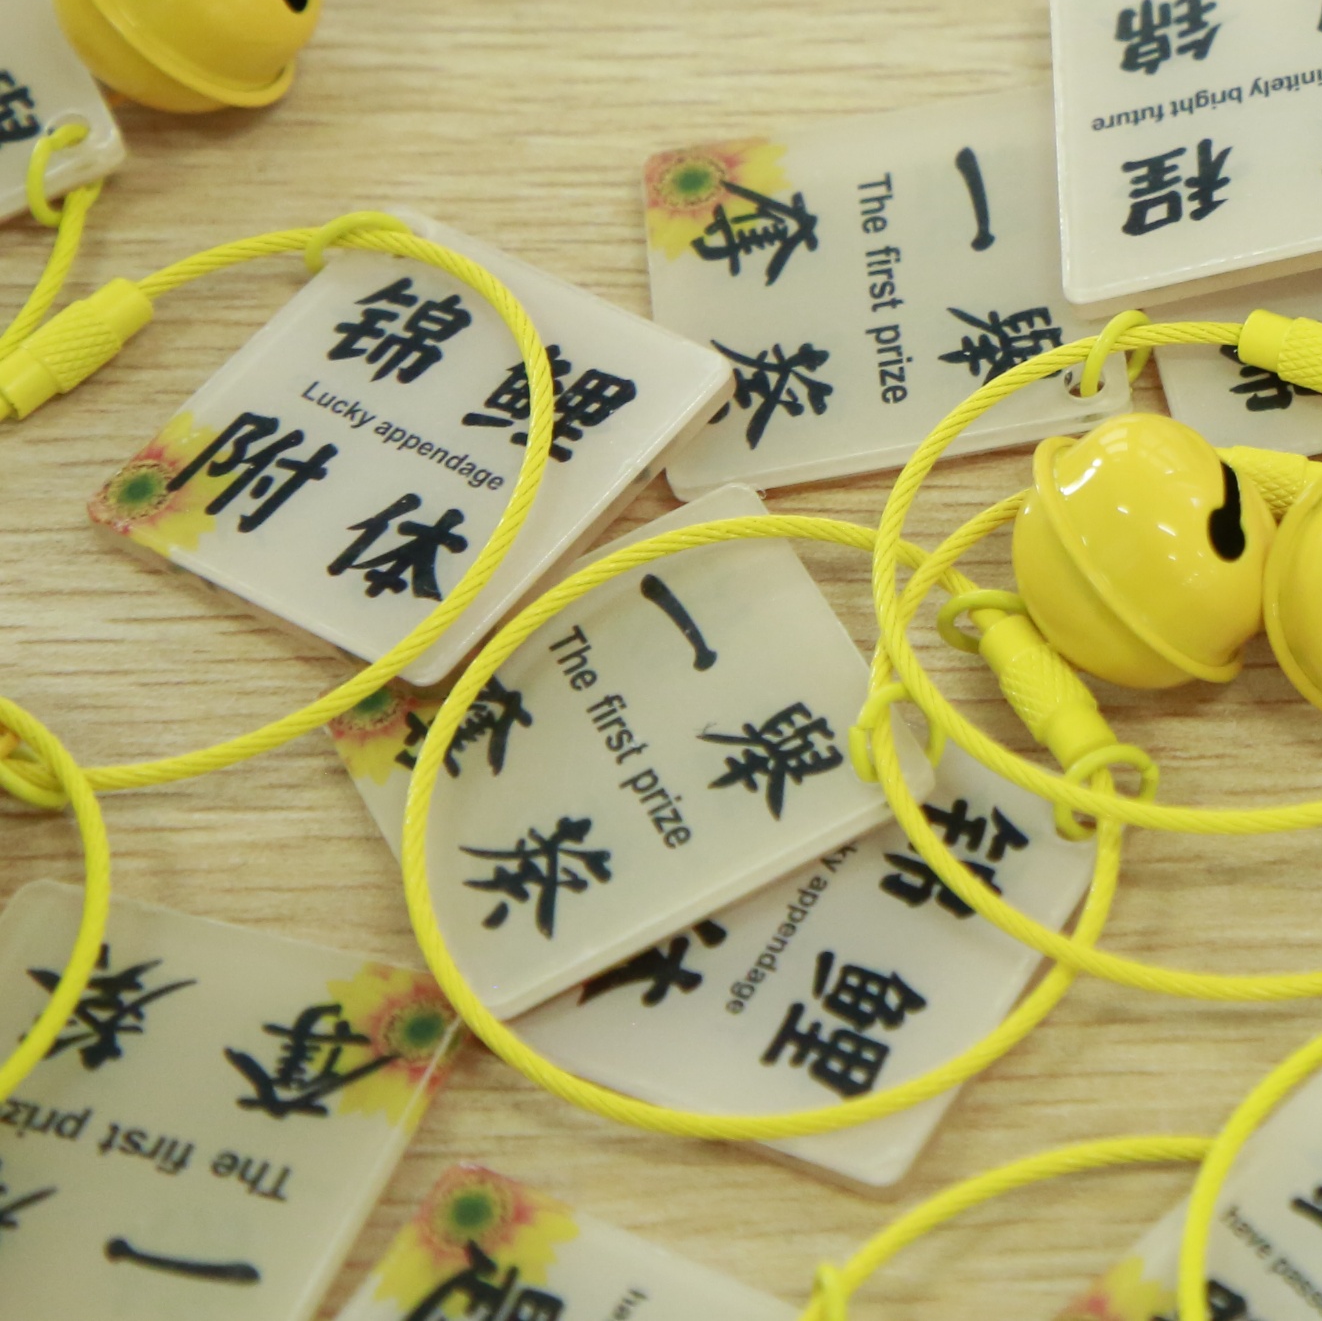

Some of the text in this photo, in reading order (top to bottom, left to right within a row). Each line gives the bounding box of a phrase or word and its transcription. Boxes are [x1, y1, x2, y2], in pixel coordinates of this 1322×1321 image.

[1091, 101, 1166, 132] future
[1171, 86, 1243, 118] bright
[856, 172, 909, 406] The first prize
[299, 378, 506, 493] Lucky appendage
[548, 624, 599, 695] The
[586, 691, 651, 768] first
[619, 766, 693, 850] prize
[724, 869, 828, 1017] appendage
[97, 1122, 195, 1176] first
[209, 1148, 292, 1203] The
[1221, 1204, 1272, 1260] have
